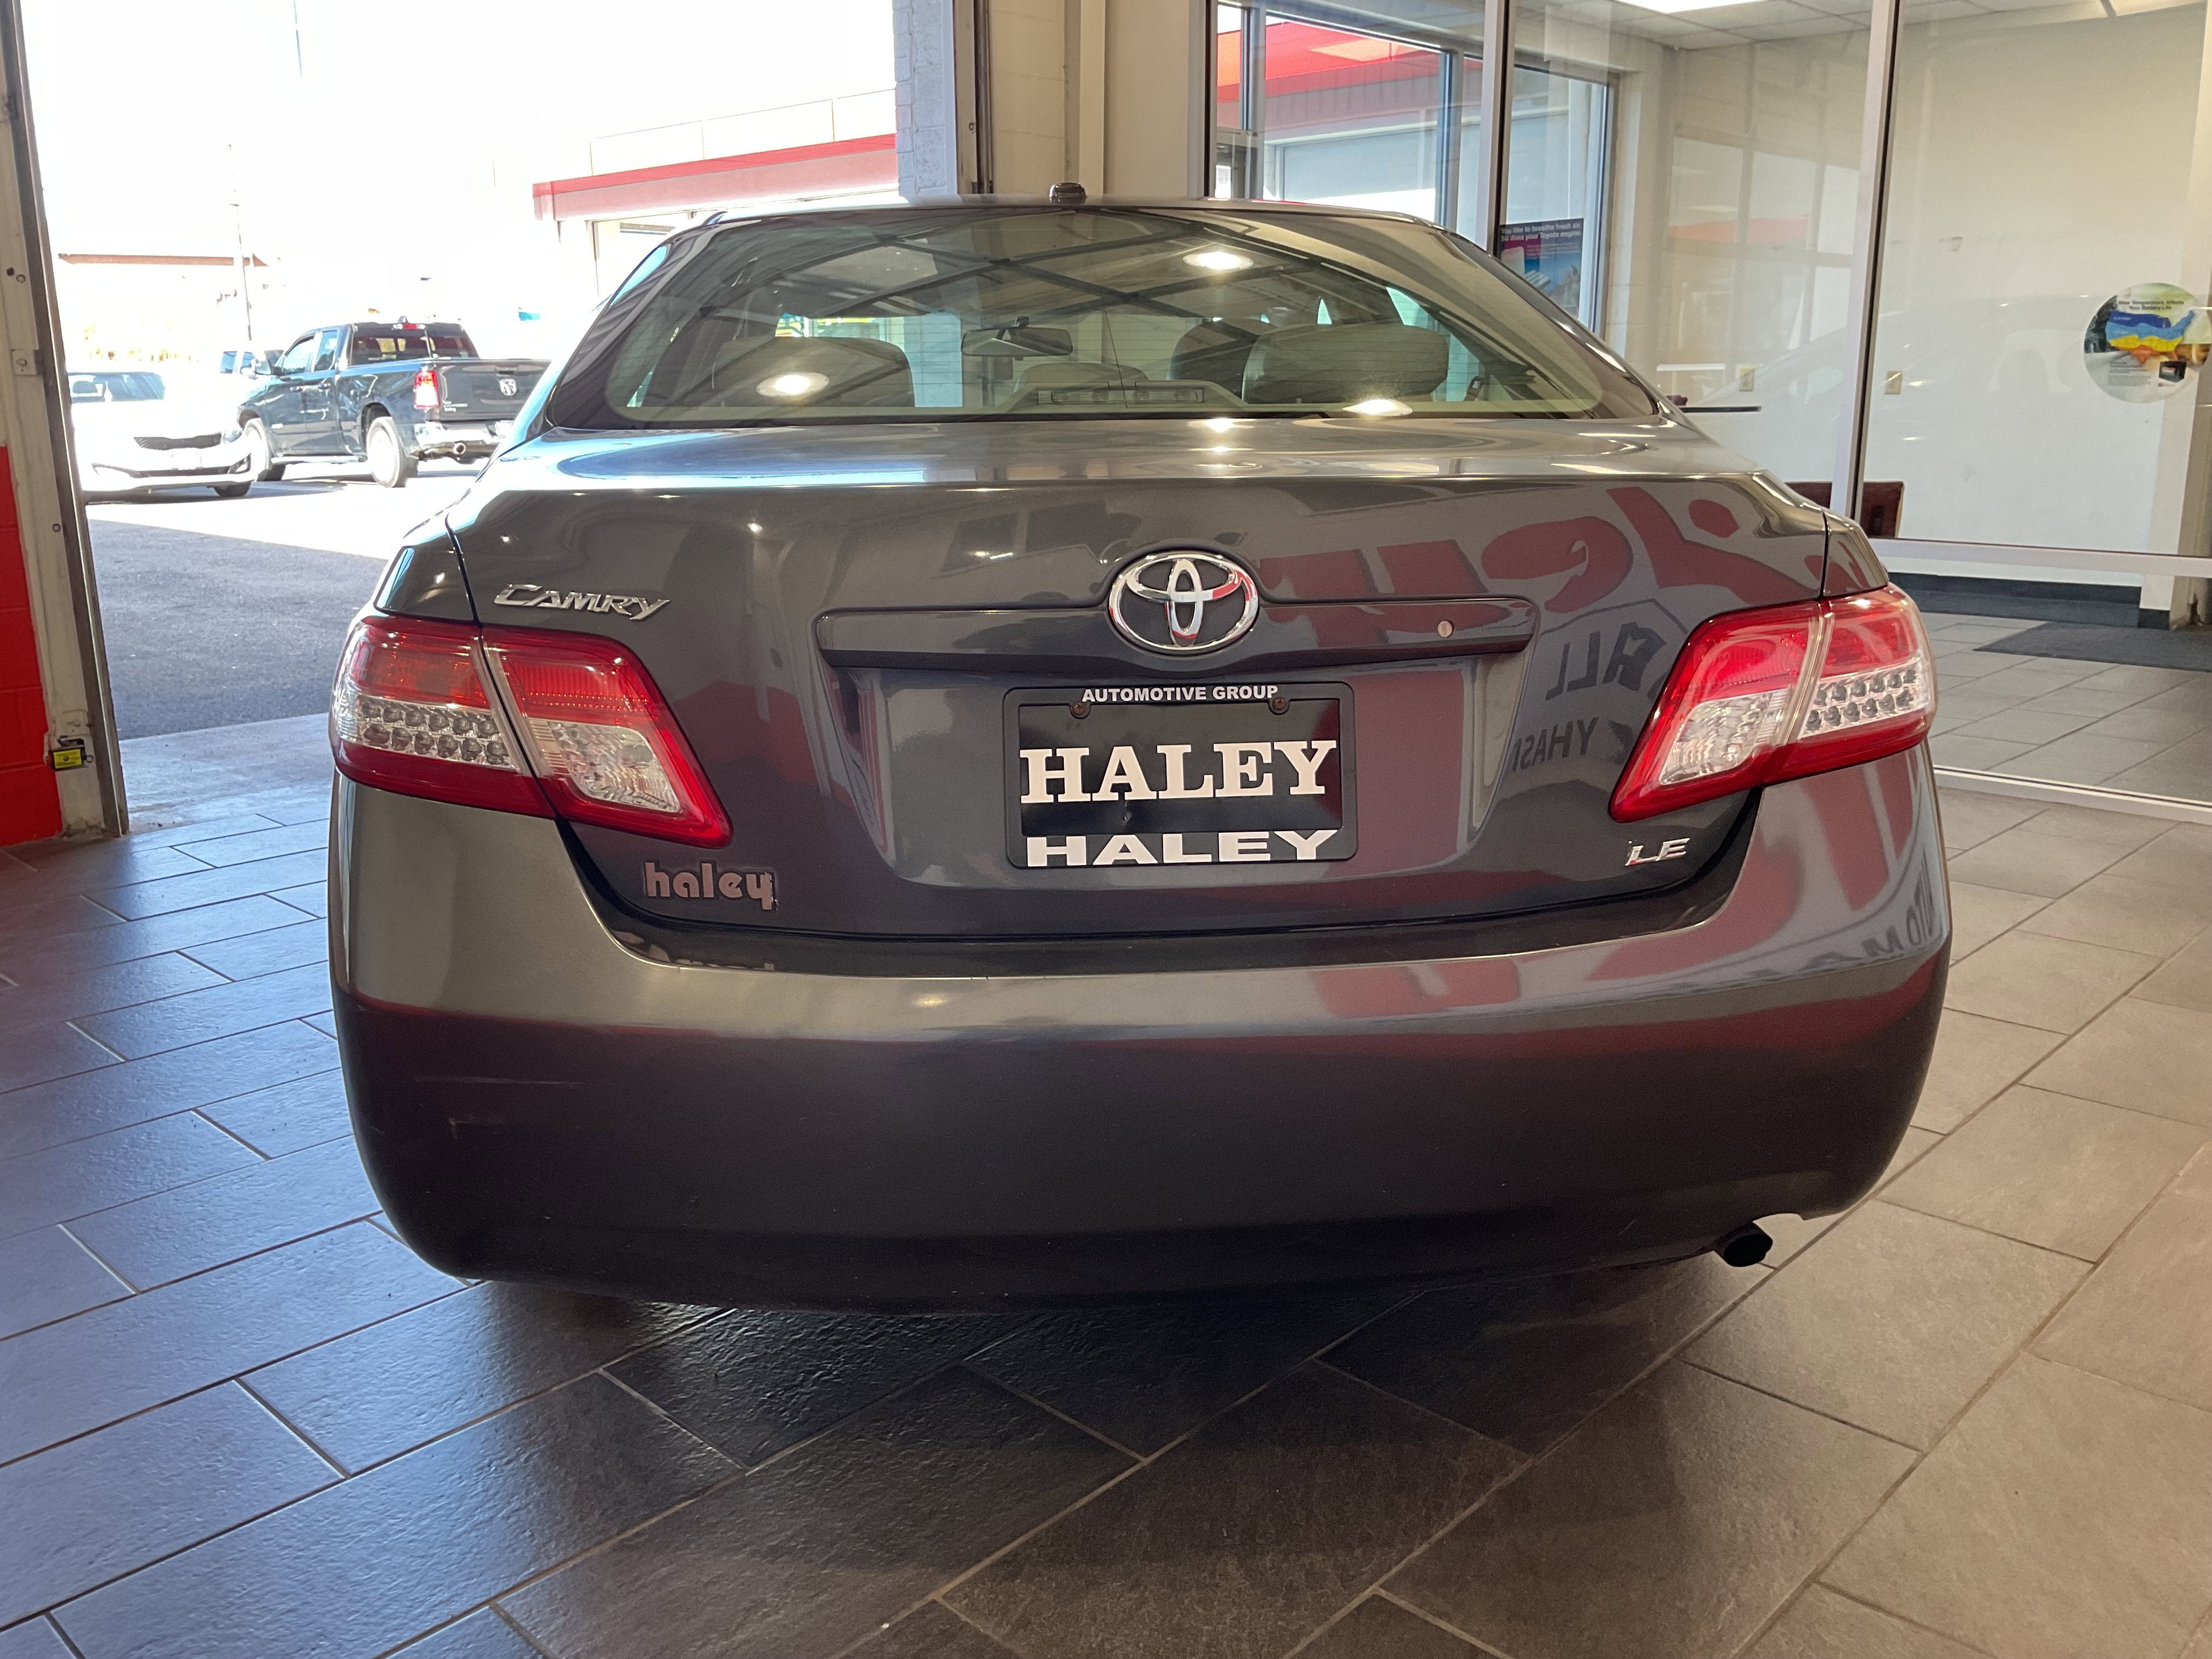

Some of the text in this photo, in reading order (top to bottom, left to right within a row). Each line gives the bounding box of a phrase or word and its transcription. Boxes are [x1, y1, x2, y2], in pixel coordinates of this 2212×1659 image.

[1525, 233, 1539, 241] your
[494, 583, 670, 621] CAMRY
[1082, 685, 1278, 703] AUTOMOTIVE GROUP
[1019, 740, 1336, 804] HALEY
[1026, 829, 1338, 867] HALEY
[1625, 837, 1691, 867] LE
[645, 861, 773, 911] haley
